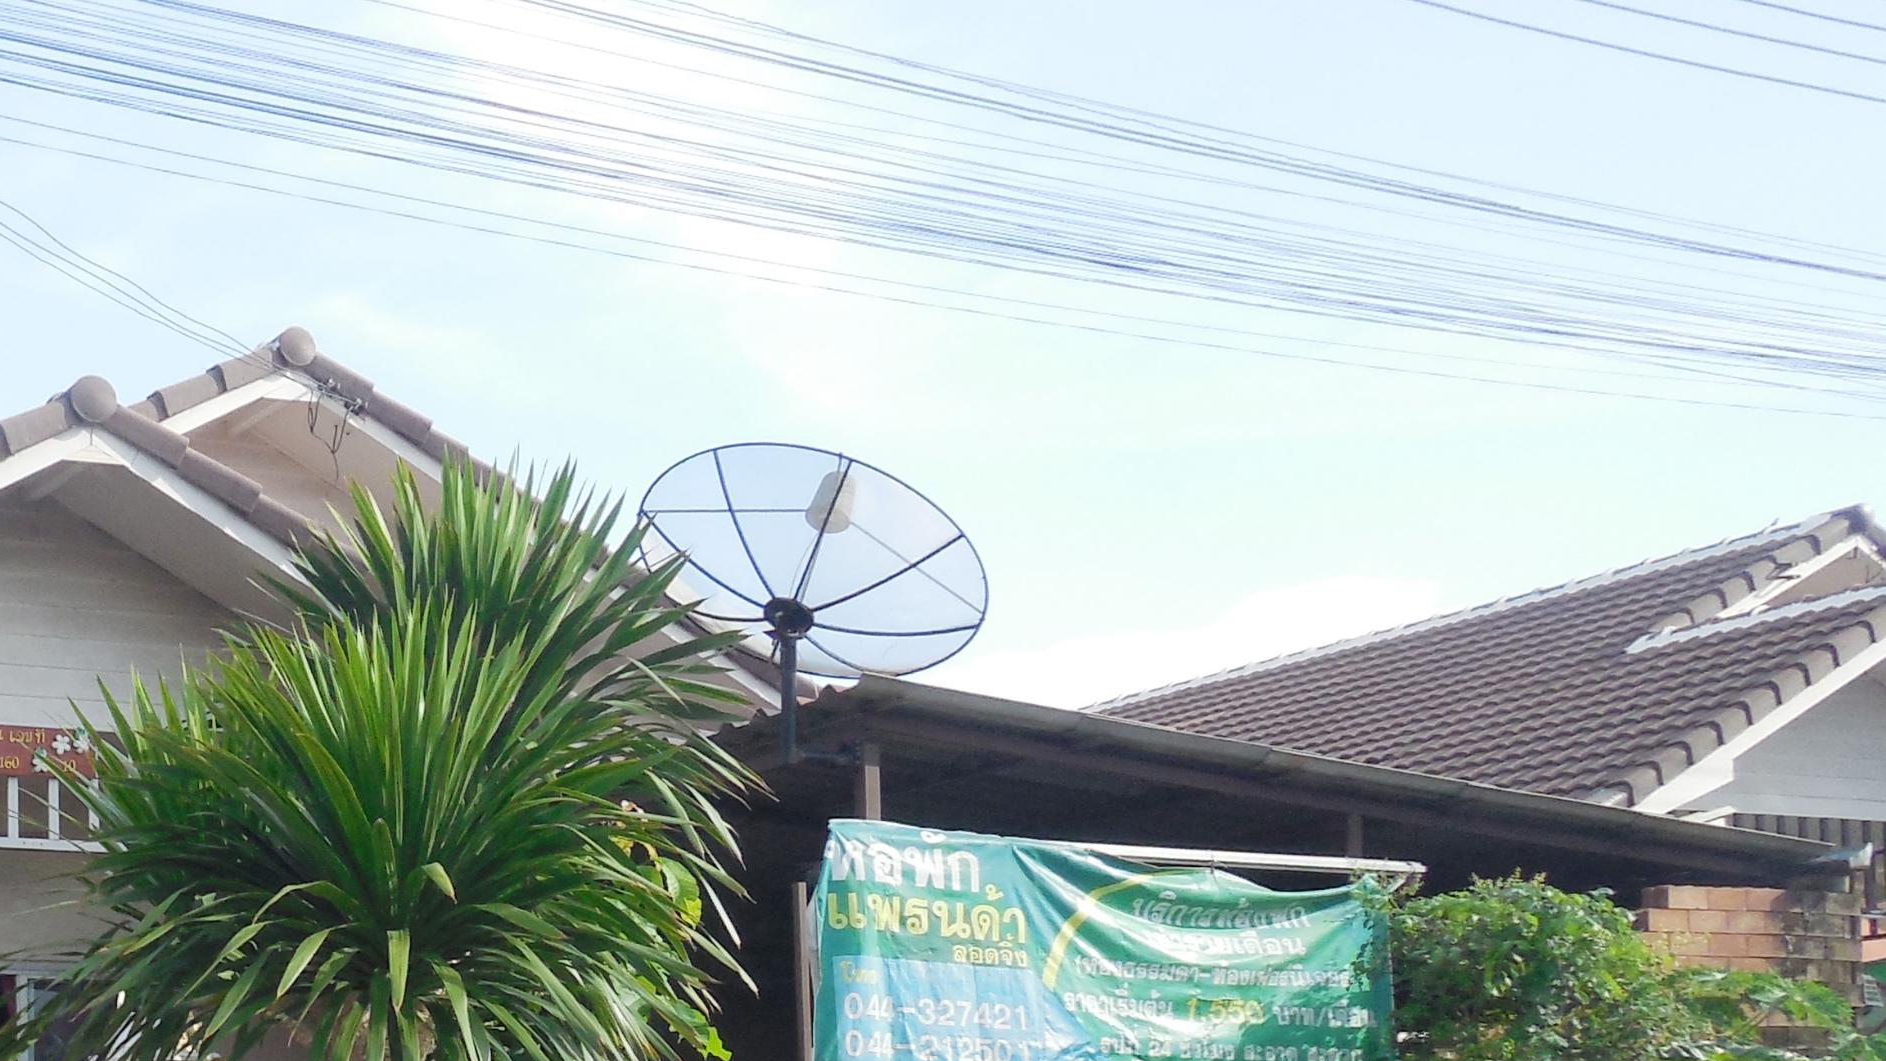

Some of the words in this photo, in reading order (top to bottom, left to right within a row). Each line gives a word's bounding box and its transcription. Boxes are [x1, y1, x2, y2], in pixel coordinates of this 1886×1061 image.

[0, 756, 20, 769] 160
[825, 830, 980, 893] หอพัก
[827, 883, 1027, 944] แพรนด้า
[843, 992, 1027, 1031] 044-327421
